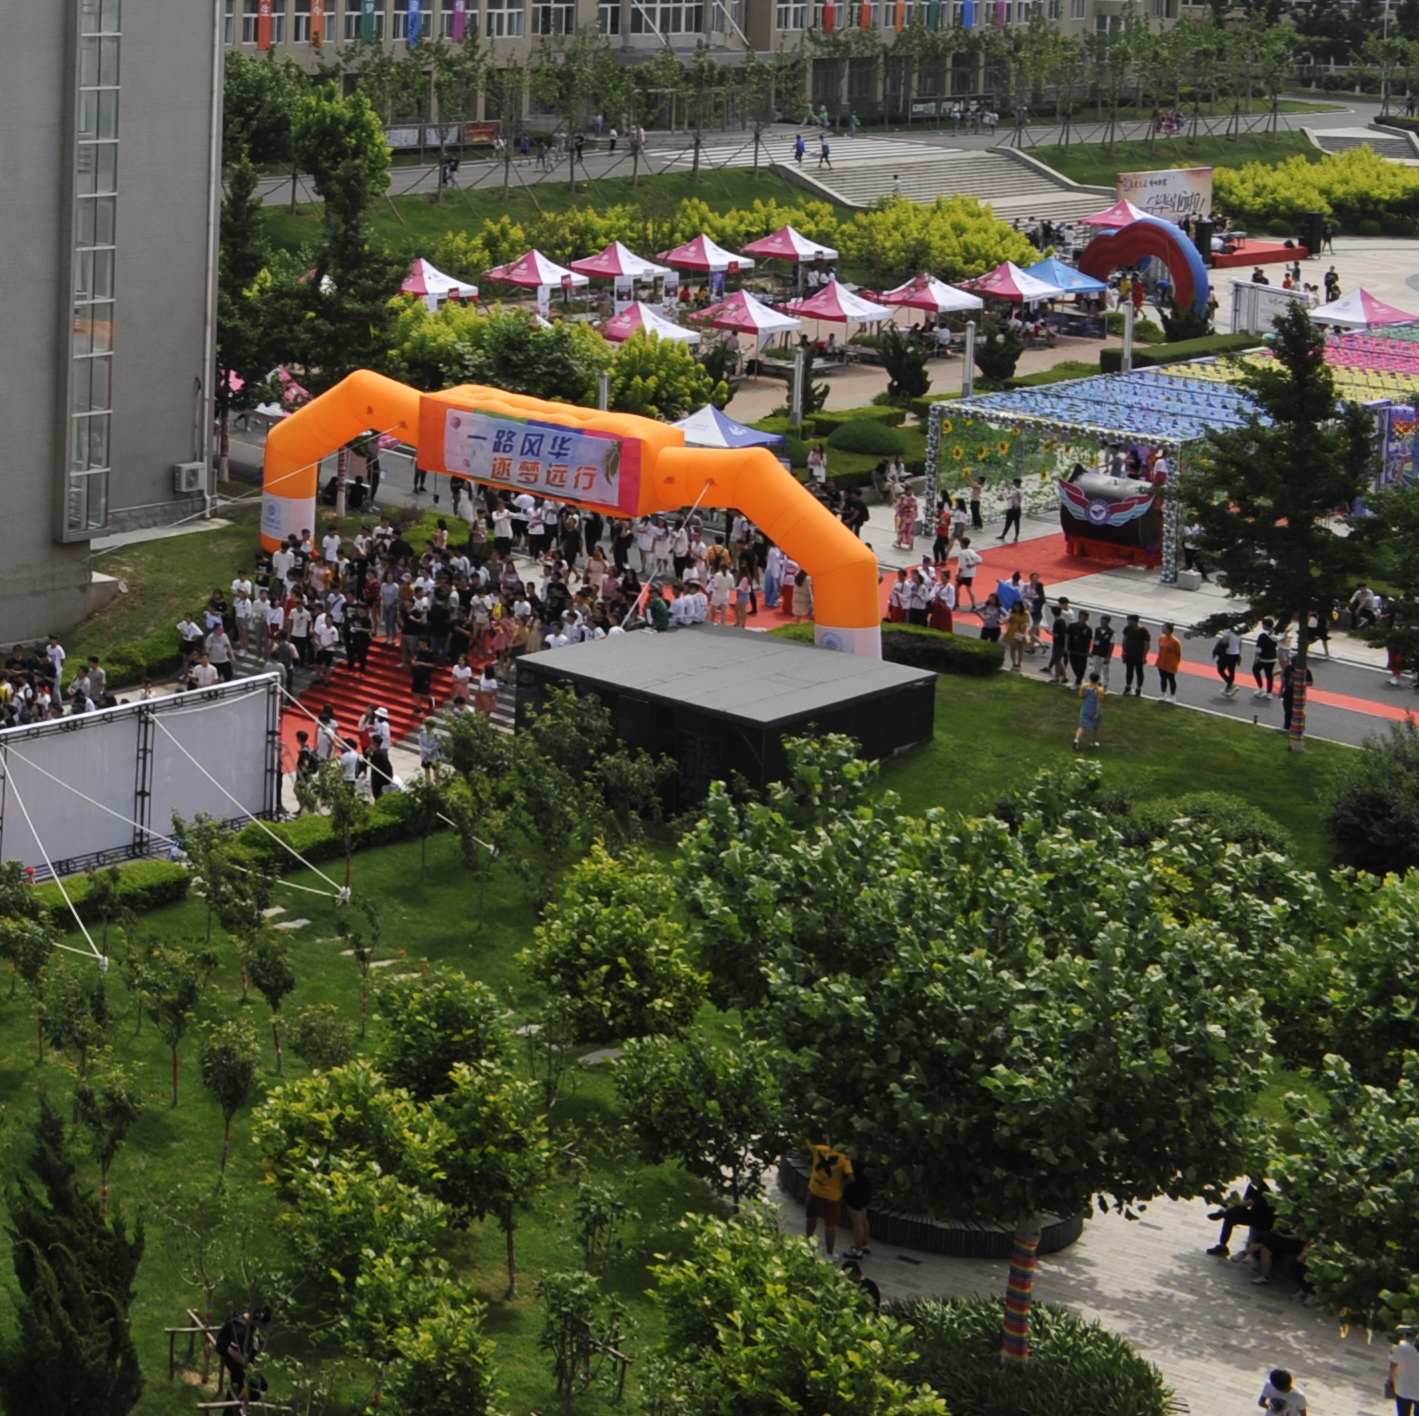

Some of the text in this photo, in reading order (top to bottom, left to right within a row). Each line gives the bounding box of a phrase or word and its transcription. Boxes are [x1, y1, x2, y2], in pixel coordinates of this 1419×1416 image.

[467, 429, 572, 459] 一路风华
[491, 457, 598, 490] 逐梦远行
